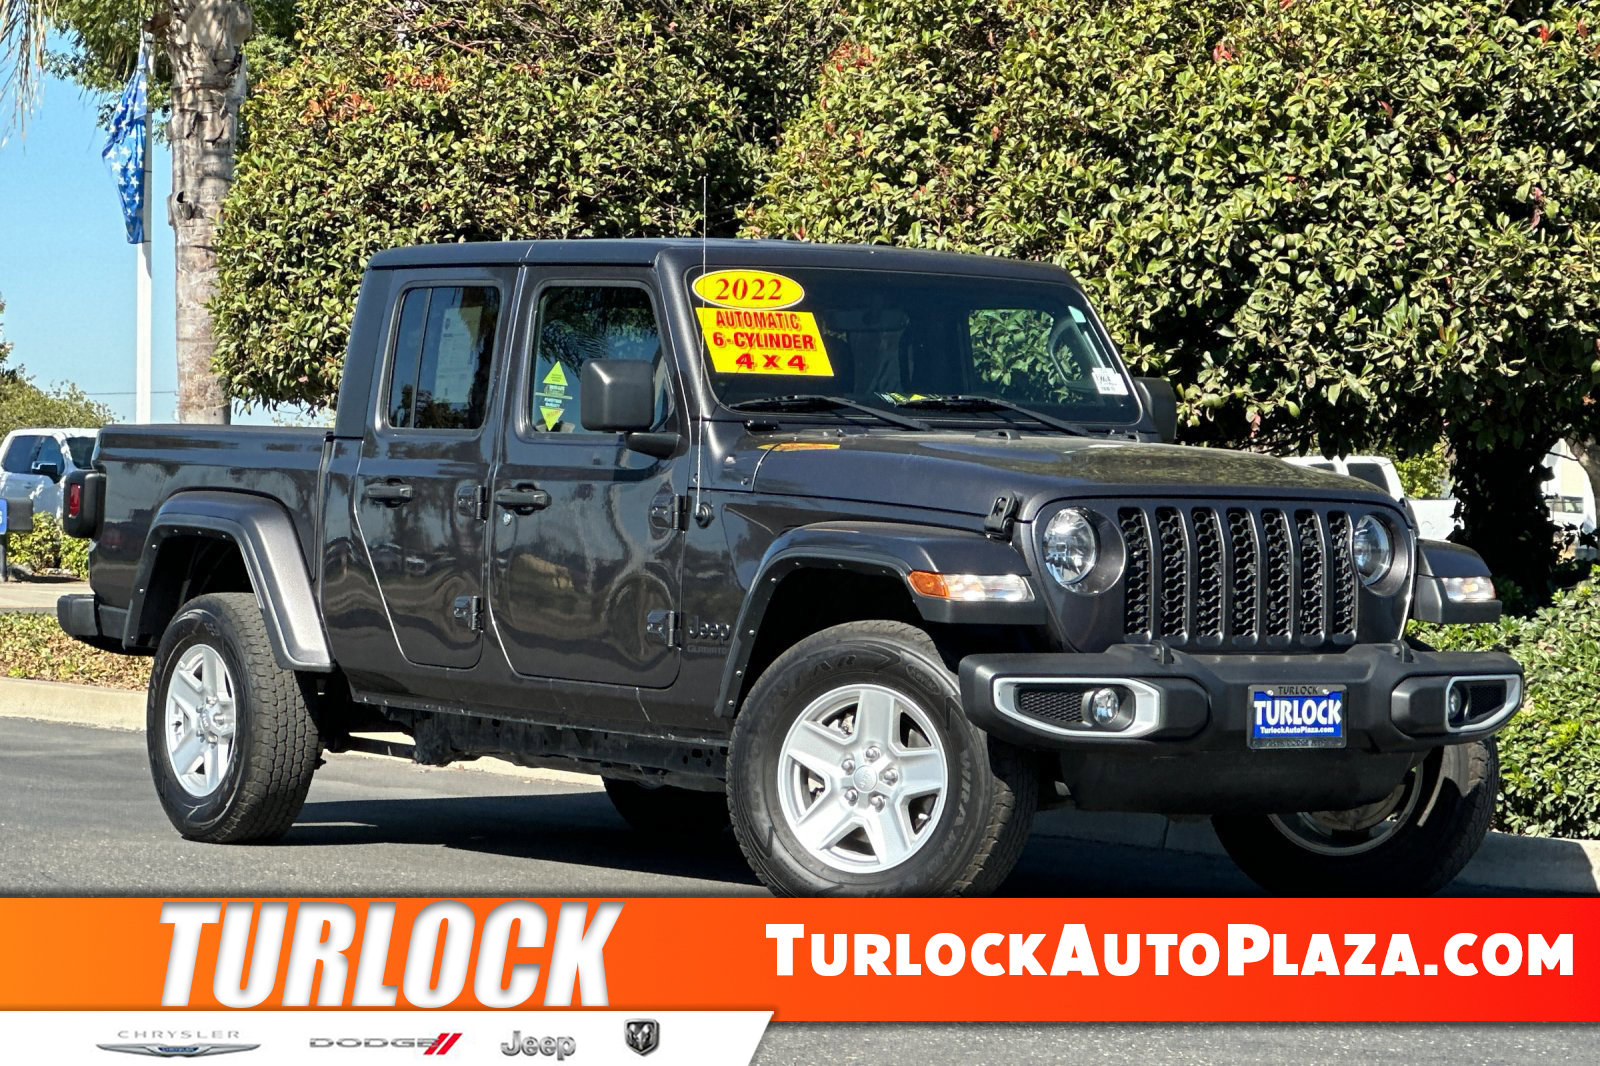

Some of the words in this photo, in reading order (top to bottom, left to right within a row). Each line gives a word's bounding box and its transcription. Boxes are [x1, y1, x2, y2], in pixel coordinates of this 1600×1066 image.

[715, 278, 783, 301] 2022
[715, 310, 801, 331] AUTOMATIC
[712, 331, 817, 351] 6-CYLINDER
[688, 615, 731, 645] Jeep
[1279, 686, 1318, 695] TURLOCK
[1253, 699, 1342, 725] TURLOCK
[1260, 726, 1334, 734] TurlockAutoPlaza.com
